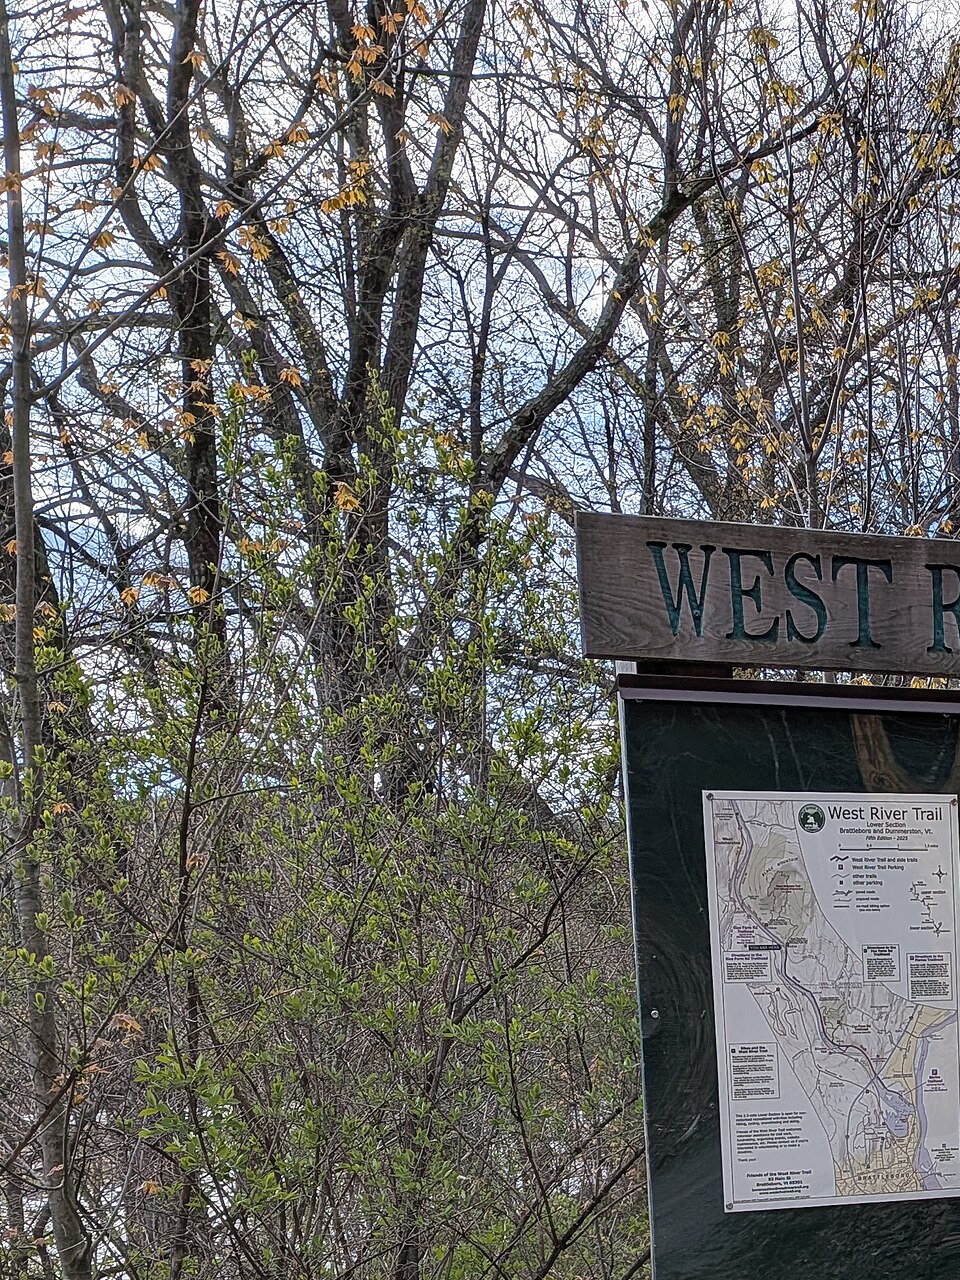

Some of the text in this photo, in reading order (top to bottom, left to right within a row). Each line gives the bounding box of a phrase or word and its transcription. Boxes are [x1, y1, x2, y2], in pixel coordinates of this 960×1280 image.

[646, 541, 892, 649] WEST
[828, 805, 865, 820] West
[870, 806, 908, 820] River
[912, 807, 942, 820] Trail
